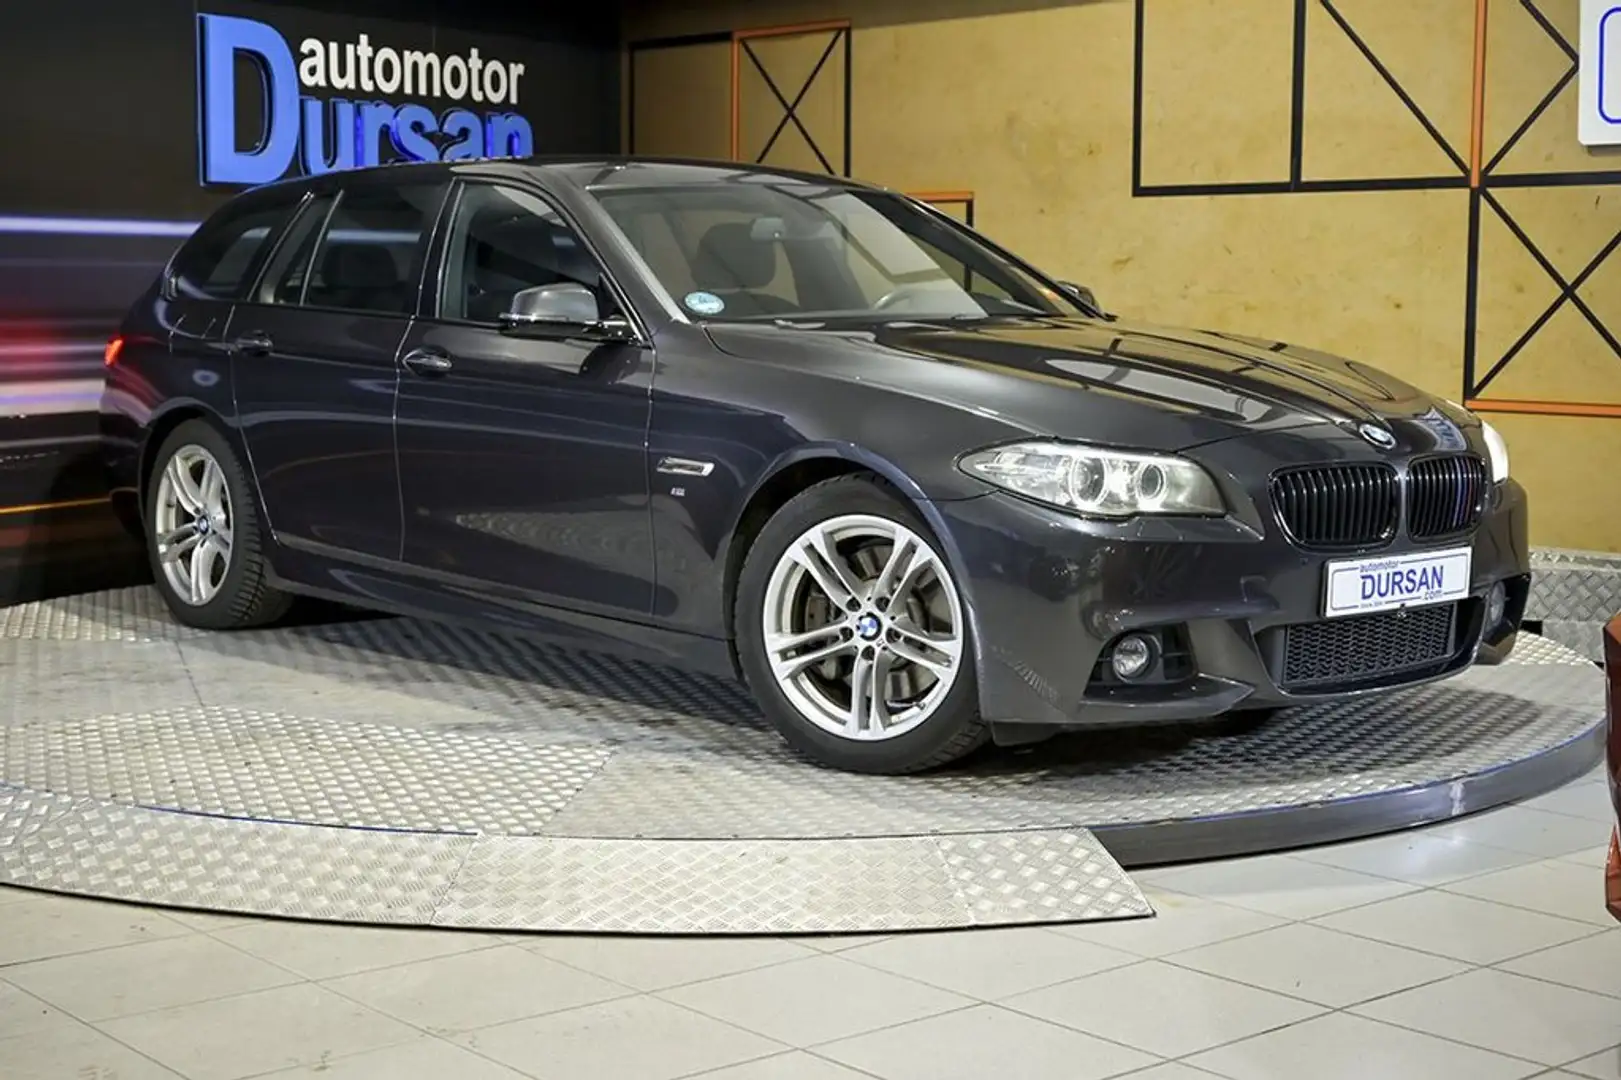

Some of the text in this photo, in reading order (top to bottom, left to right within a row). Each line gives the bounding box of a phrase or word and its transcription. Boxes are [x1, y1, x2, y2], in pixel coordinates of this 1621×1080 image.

[300, 34, 525, 104] automotor
[197, 13, 534, 186] Dursan
[1360, 560, 1400, 573] automotor
[1360, 565, 1444, 600] DURSAN
